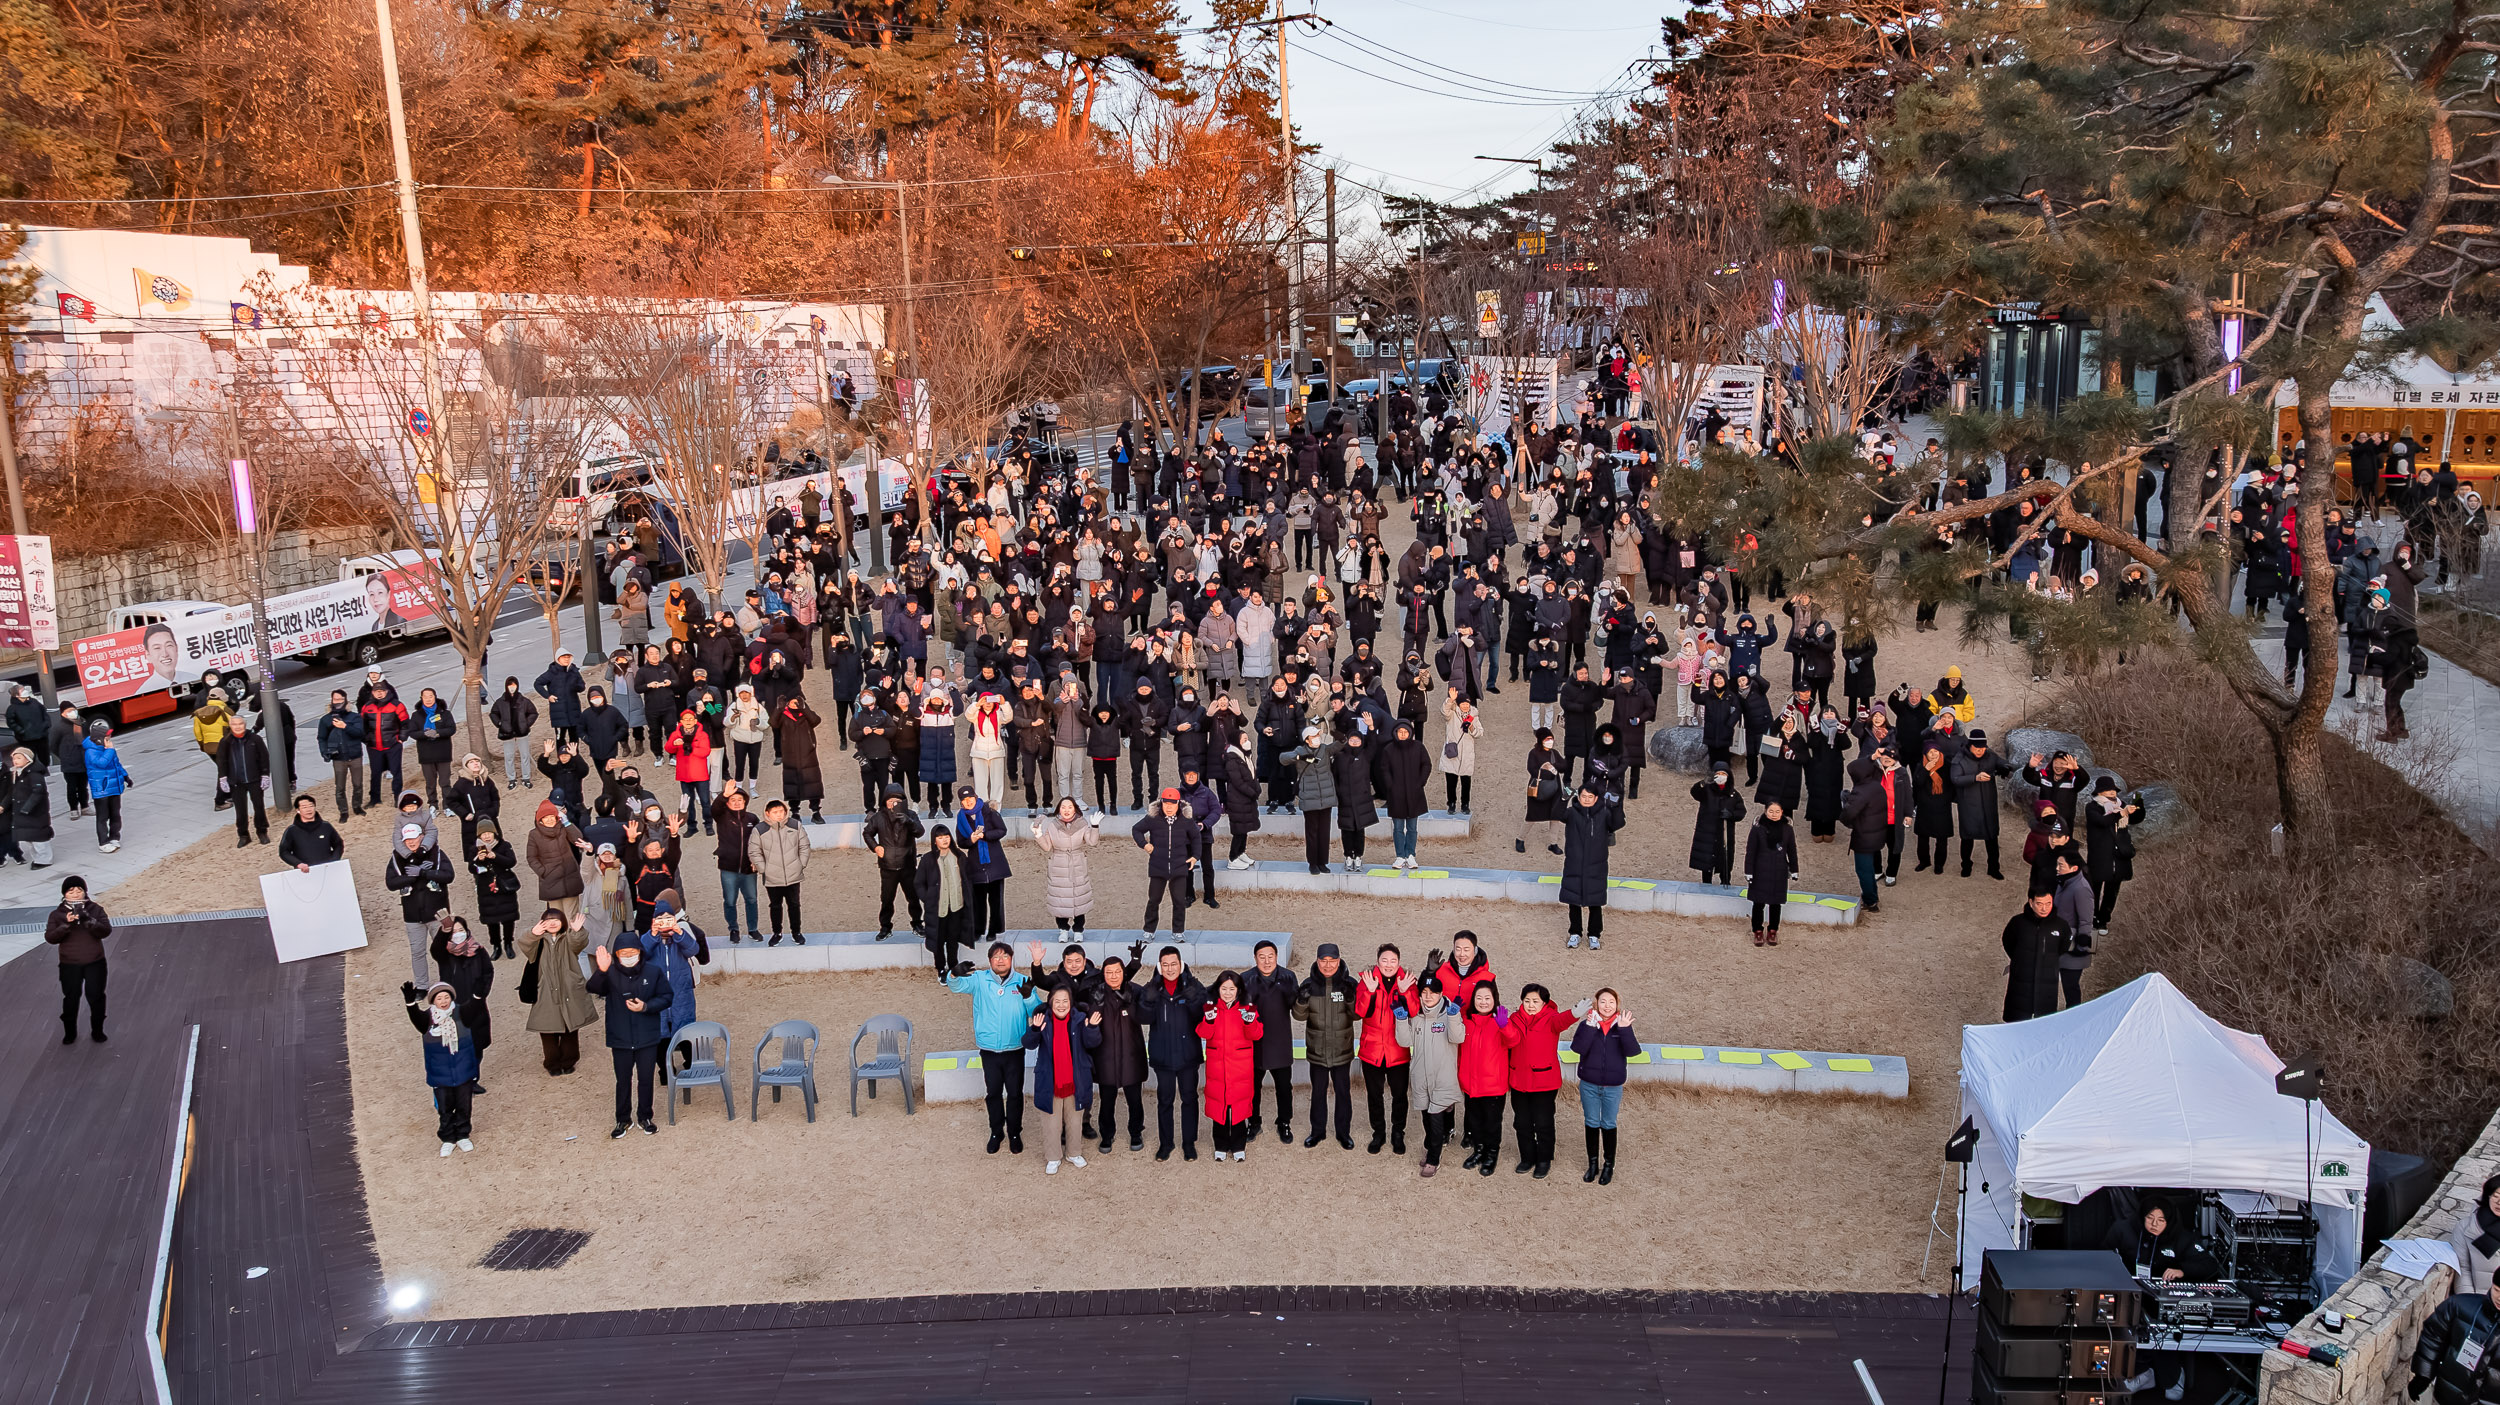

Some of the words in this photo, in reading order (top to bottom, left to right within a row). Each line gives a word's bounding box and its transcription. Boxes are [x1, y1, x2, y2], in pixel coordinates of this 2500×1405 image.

[2393, 391, 2421, 403] 띠별
[2431, 391, 2460, 404] 운세
[0, 565, 17, 575] 026
[0, 577, 21, 589] 차산
[0, 590, 23, 602] 맞이
[186, 623, 256, 660] 동서울터미
[305, 605, 329, 632] 사업
[329, 595, 369, 623] 가속화!
[250, 640, 296, 663] 갈해소
[299, 625, 347, 649] 문제해결!
[84, 655, 150, 689] 오신환
[2284, 1069, 2305, 1080] SHURE
